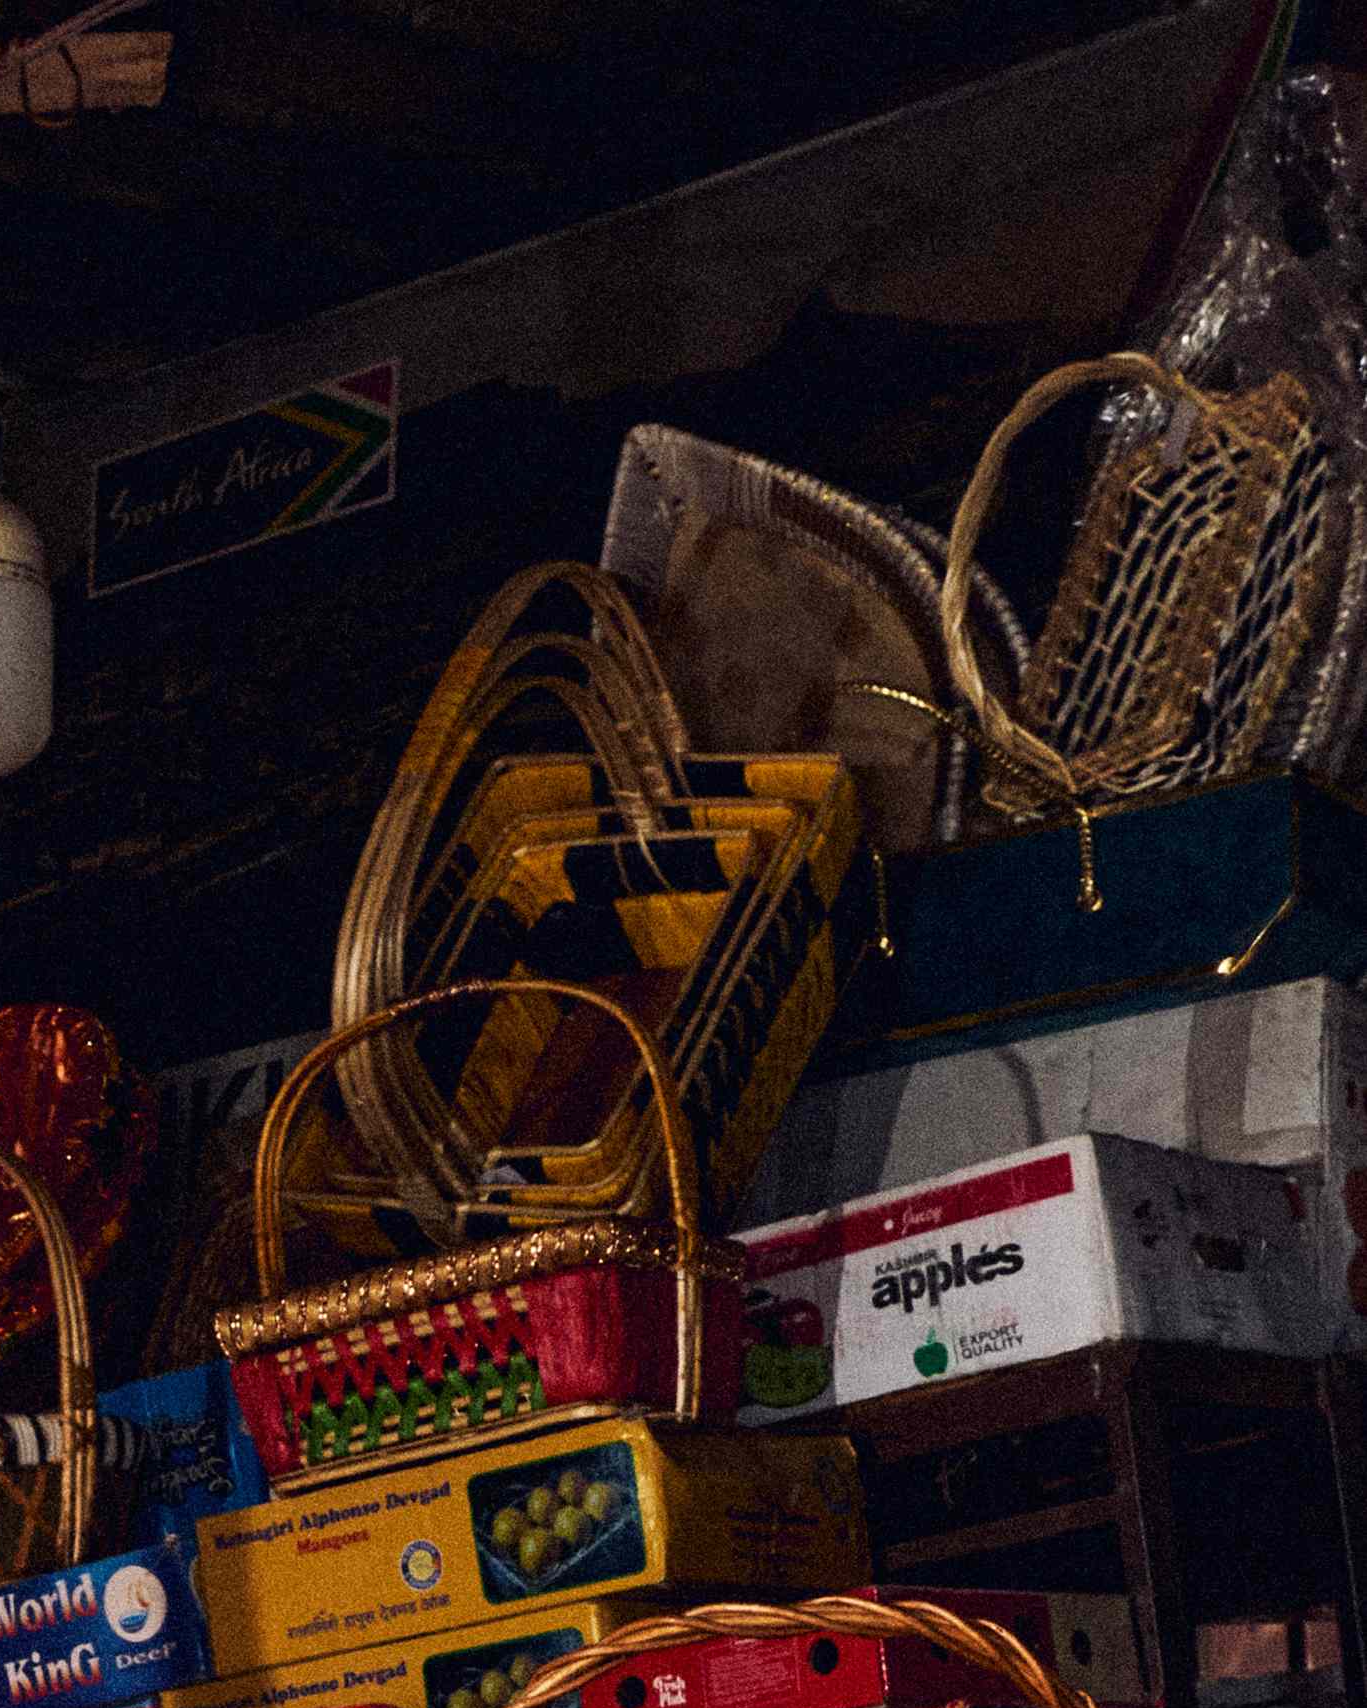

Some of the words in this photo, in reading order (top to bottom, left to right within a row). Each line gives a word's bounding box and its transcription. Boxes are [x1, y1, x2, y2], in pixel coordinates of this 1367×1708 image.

[212, 432, 314, 505] Africa
[871, 1243, 1024, 1312] apples
[959, 1324, 1019, 1350] EXPORT
[960, 1334, 1025, 1361] QUALITY
[299, 1502, 381, 1531] Alphonse
[385, 1481, 452, 1509] Devgad
[343, 1660, 408, 1688] Devgad
